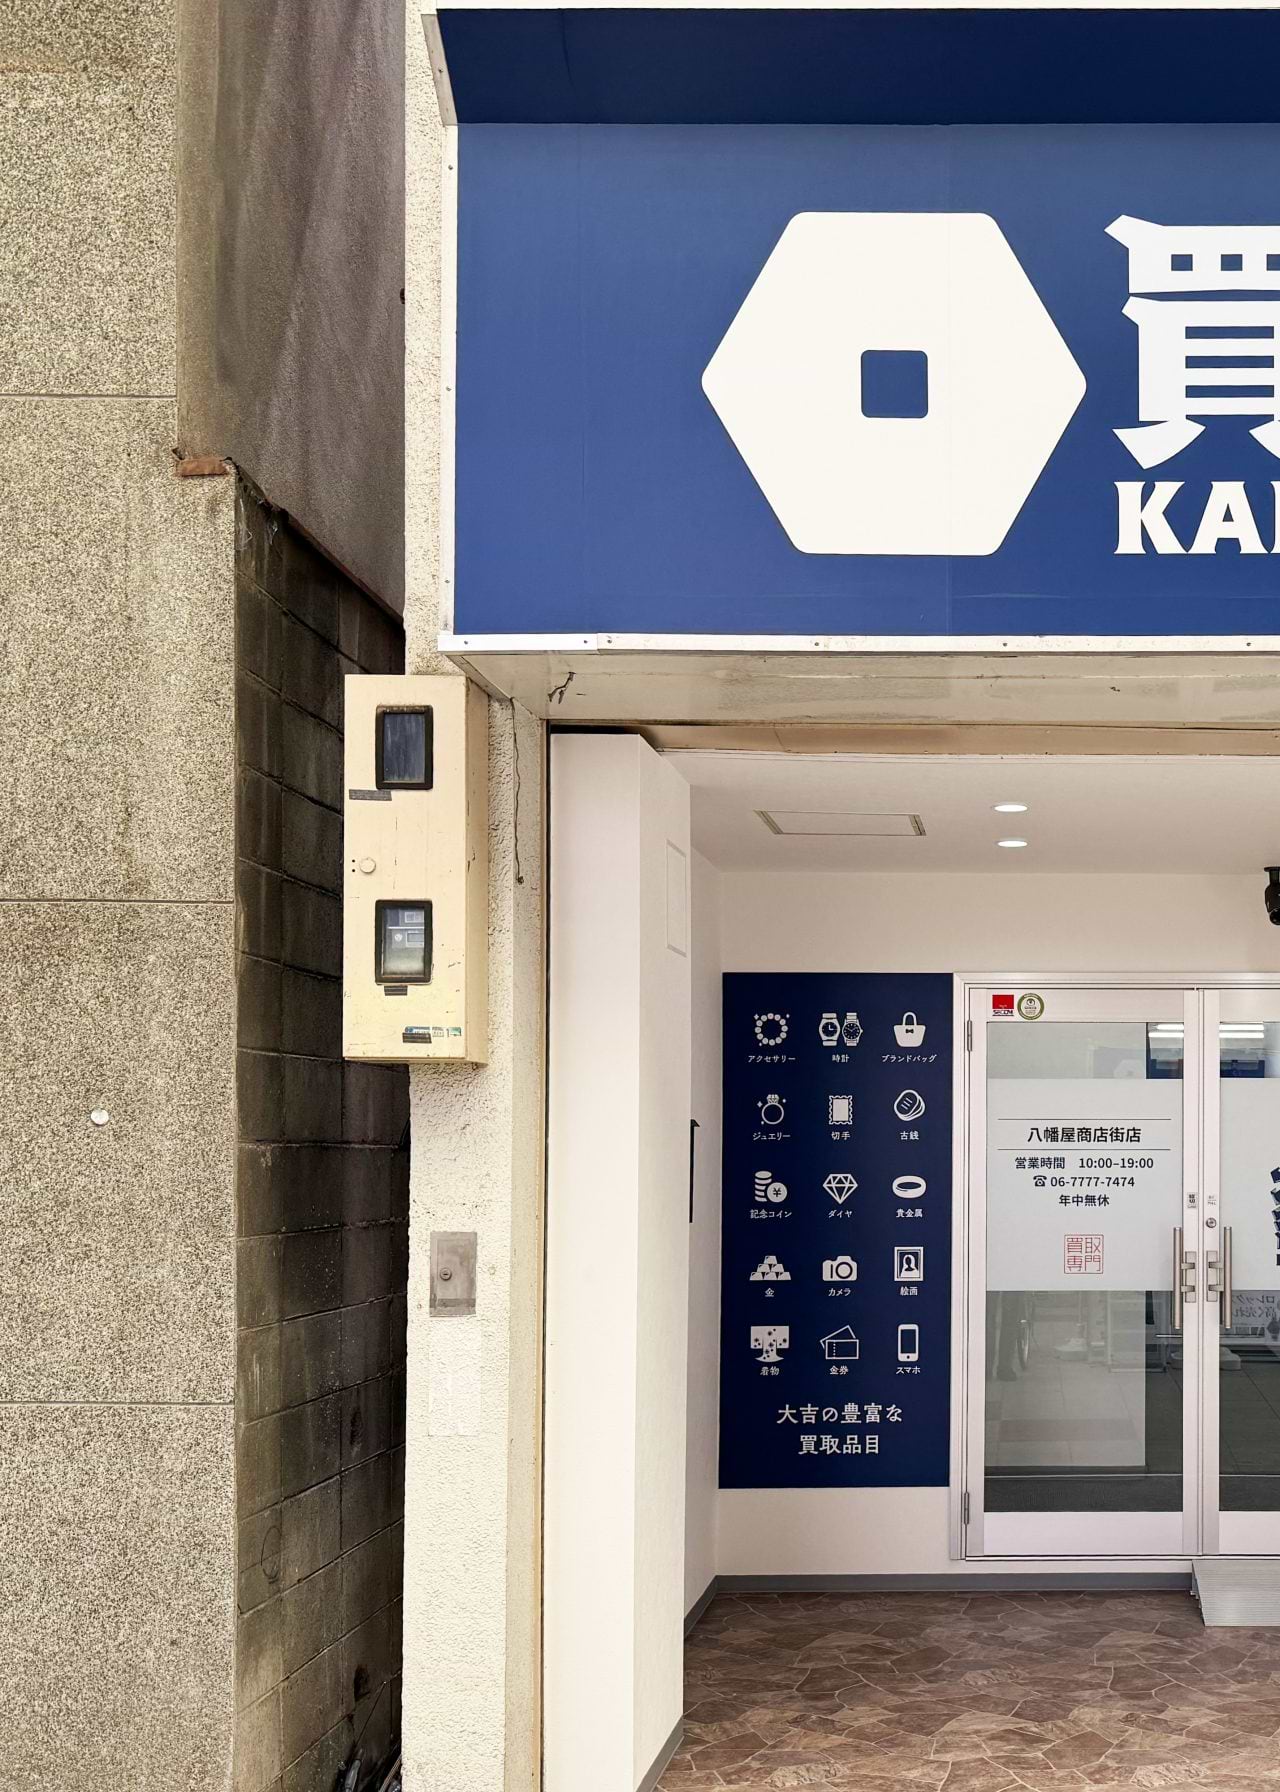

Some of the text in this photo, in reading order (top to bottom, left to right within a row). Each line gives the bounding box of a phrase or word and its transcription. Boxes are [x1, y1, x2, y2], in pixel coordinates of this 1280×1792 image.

[748, 1054, 796, 1063] アクセサリー
[831, 1053, 850, 1063] 時計
[881, 1054, 937, 1063] ブランドバッグ
[752, 1131, 791, 1141] ジュエリー
[831, 1131, 851, 1141] 切手
[899, 1130, 920, 1141] 古銭
[1027, 1126, 1142, 1143] 八幡屋商店街店
[1014, 1156, 1066, 1170] 営業時間
[1050, 1176, 1136, 1188] 06-7777-7474
[1058, 1194, 1110, 1207] 年中無休
[749, 1208, 793, 1219] 記念コイン
[828, 1209, 853, 1219] ダイヤ
[895, 1208, 923, 1218] 貴金属
[764, 1287, 775, 1298] 金
[828, 1287, 851, 1297] カメラ
[899, 1286, 918, 1296] 絵画
[829, 1365, 849, 1375] 金券
[895, 1365, 921, 1375] スマホ
[776, 1402, 904, 1425] 大吉の豊富な
[798, 1434, 880, 1455] 買取品目
